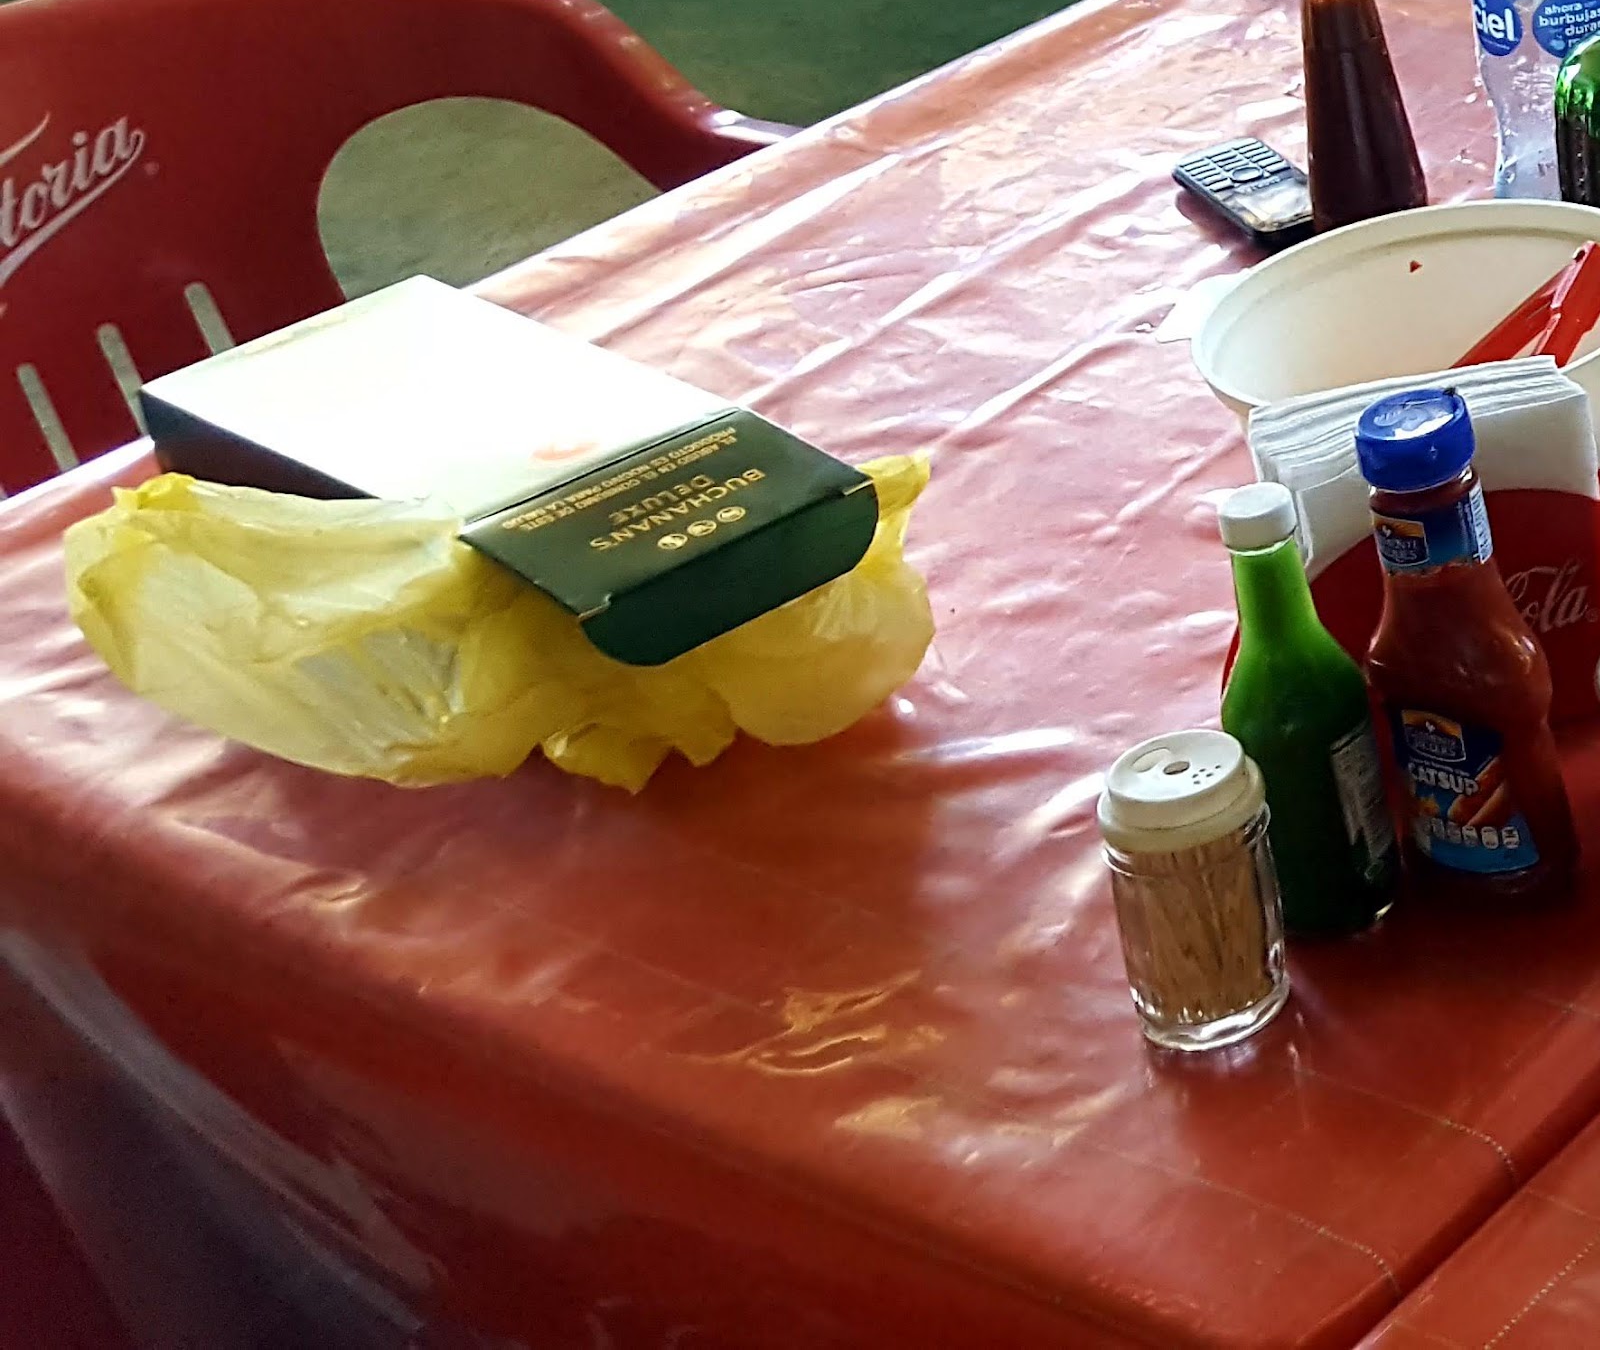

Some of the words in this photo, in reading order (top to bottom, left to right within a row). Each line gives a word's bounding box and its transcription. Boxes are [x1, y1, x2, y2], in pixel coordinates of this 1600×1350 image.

[1544, 2, 1583, 15] ahora
[0, 114, 145, 262] toria
[590, 468, 766, 551] BUCHANAN'S
[608, 474, 716, 526] DELUXE
[1408, 762, 1480, 795] CATSUP
